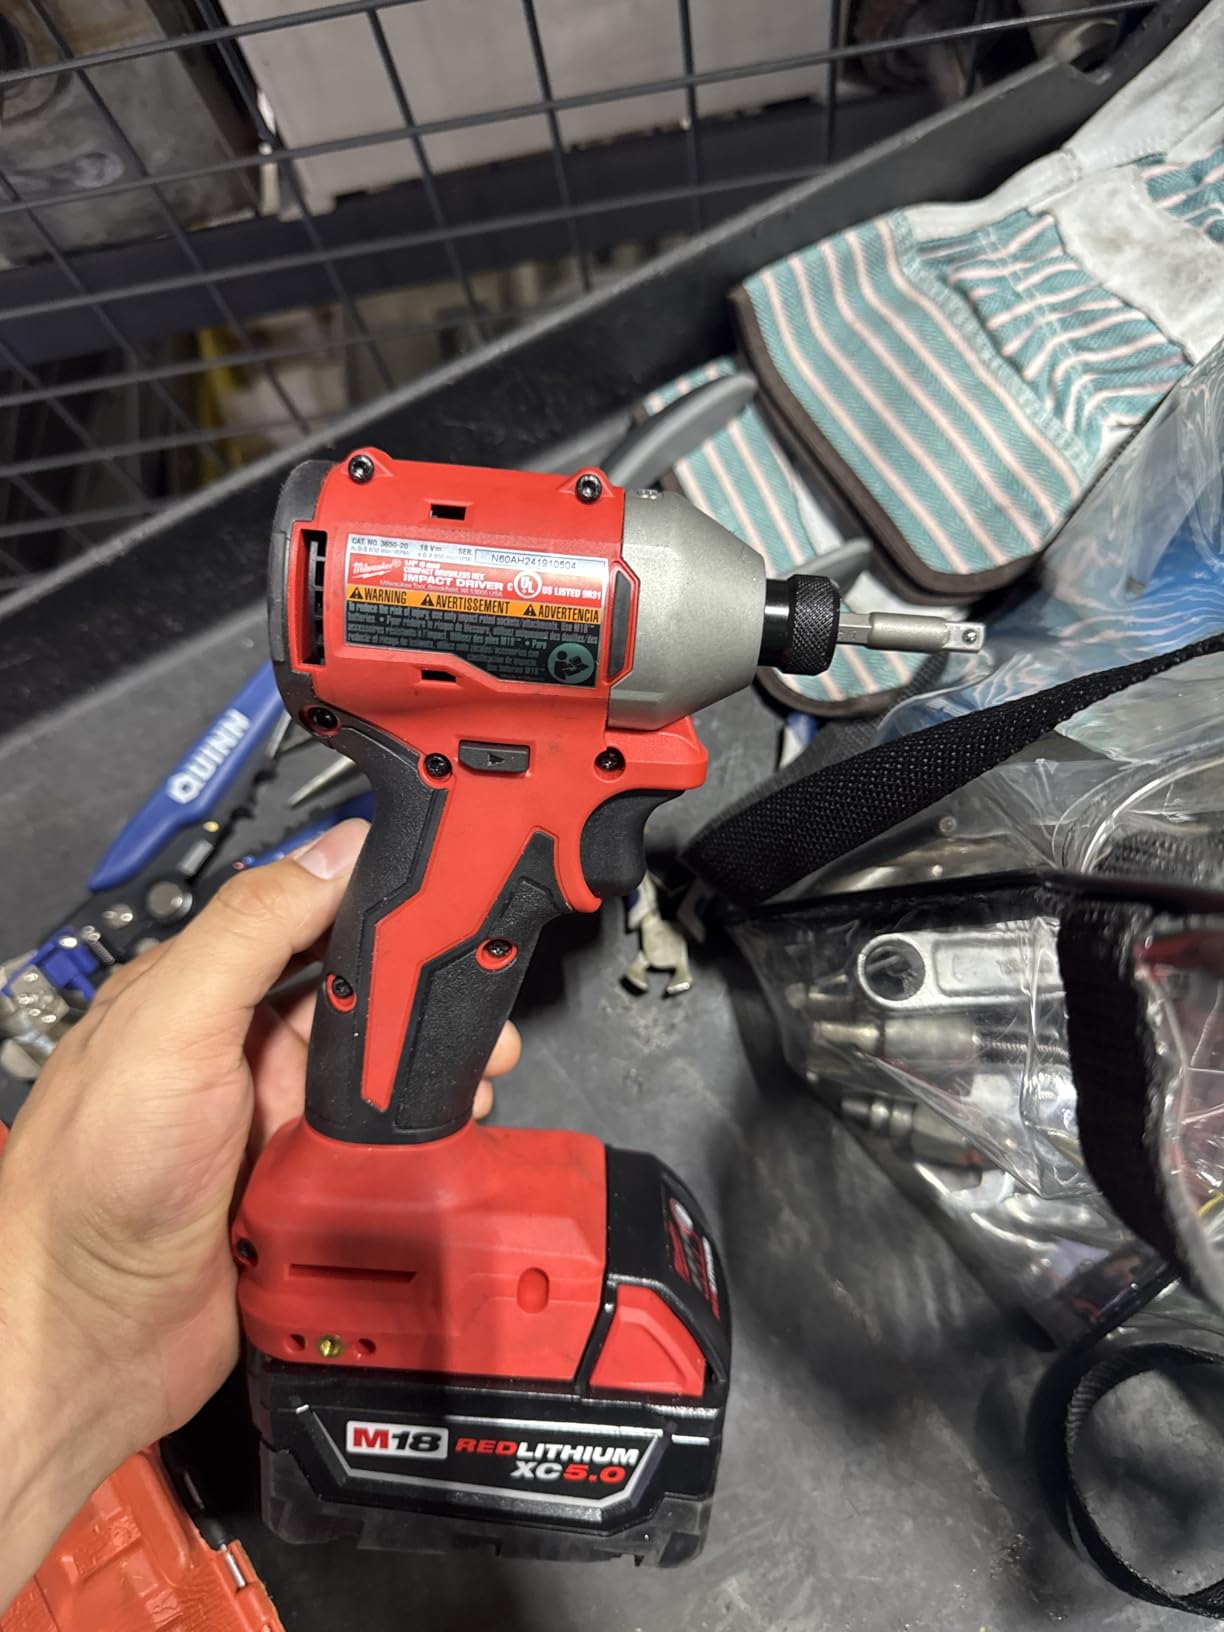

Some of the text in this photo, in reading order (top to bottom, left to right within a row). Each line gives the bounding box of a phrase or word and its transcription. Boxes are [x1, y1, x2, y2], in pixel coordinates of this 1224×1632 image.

[403, 573, 504, 591] IMPACT DRIVER
[554, 586, 580, 598] LISTED
[364, 588, 407, 604] WARNING
[436, 594, 510, 615] AVERTISSEMENT
[538, 605, 599, 623] ADVERTENCIA
[167, 708, 250, 805] QUINN
[352, 1427, 442, 1453] M18
[454, 1437, 640, 1465] REDLITHIUM
[509, 1459, 627, 1484] XC5.0
